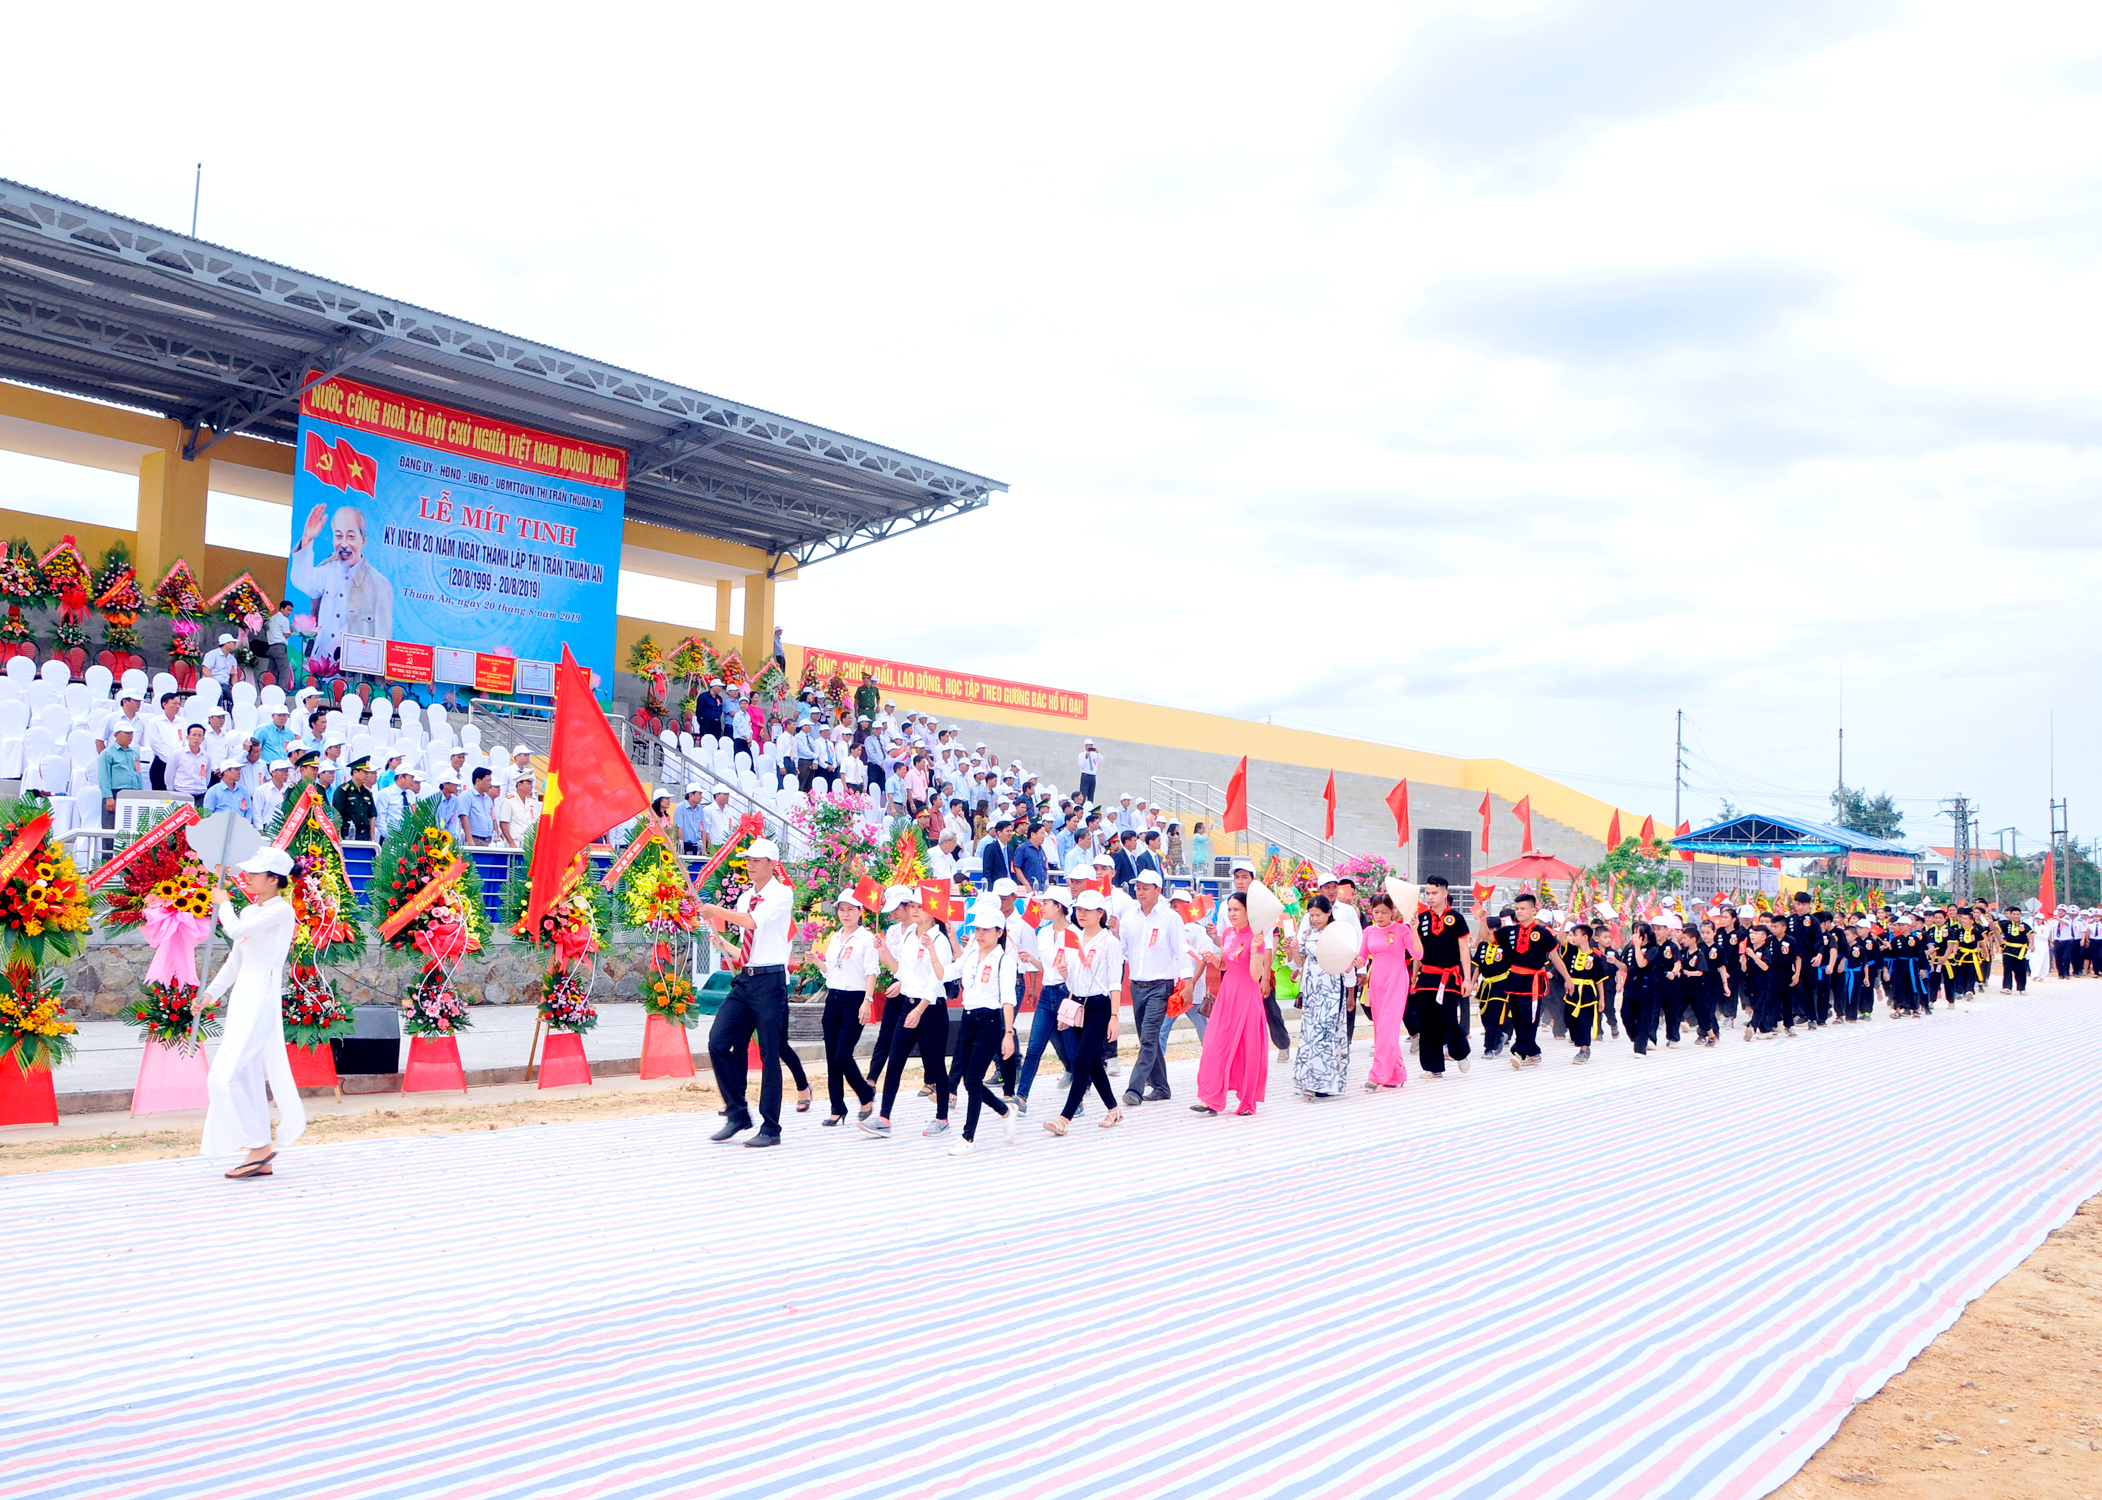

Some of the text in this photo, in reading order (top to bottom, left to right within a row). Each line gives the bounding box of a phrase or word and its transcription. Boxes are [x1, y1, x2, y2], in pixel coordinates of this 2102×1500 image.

[311, 382, 620, 480] NƯỚC CỘNG HOÀ XÃ HỘI CHỦ NGHĨA VIỆT NAM MUÔN NĂM!
[399, 453, 421, 471] ĐẢNG
[423, 457, 433, 474] ỦY
[440, 465, 461, 480] HĐND
[468, 471, 489, 486] UBND
[495, 478, 535, 497] UBMTTQVN
[536, 486, 548, 501] THỊ
[549, 487, 568, 503] TRẤN
[569, 493, 591, 509] THUẬN
[592, 498, 603, 510] AN
[418, 490, 577, 547] LỄ MÍT TINH
[383, 521, 603, 584] KỶ NIỆM 20 NĂM NGÀY THÀNH LẬP THỊ TRẤN THUẬN AN
[402, 587, 581, 623] Thuận An, ngày 20 tháng 8 năm 2019
[449, 566, 492, 591] (20/8/1999
[499, 575, 541, 600] 20/8/2019)
[874, 663, 896, 688] ĐẤU,
[897, 669, 914, 689] LAO
[916, 670, 943, 695] ĐỘNG,
[945, 677, 963, 699] HỌC
[964, 678, 980, 702] TẬP
[982, 683, 1002, 703] THEO
[1003, 686, 1030, 707] GƯƠNG
[1031, 689, 1047, 709] BÁC
[1048, 690, 1059, 711] HỒ
[1060, 694, 1068, 712] VĨ
[1068, 698, 1084, 717] ĐẠI!
[1, 849, 29, 883] Mừng
[415, 892, 436, 912] Chúc
